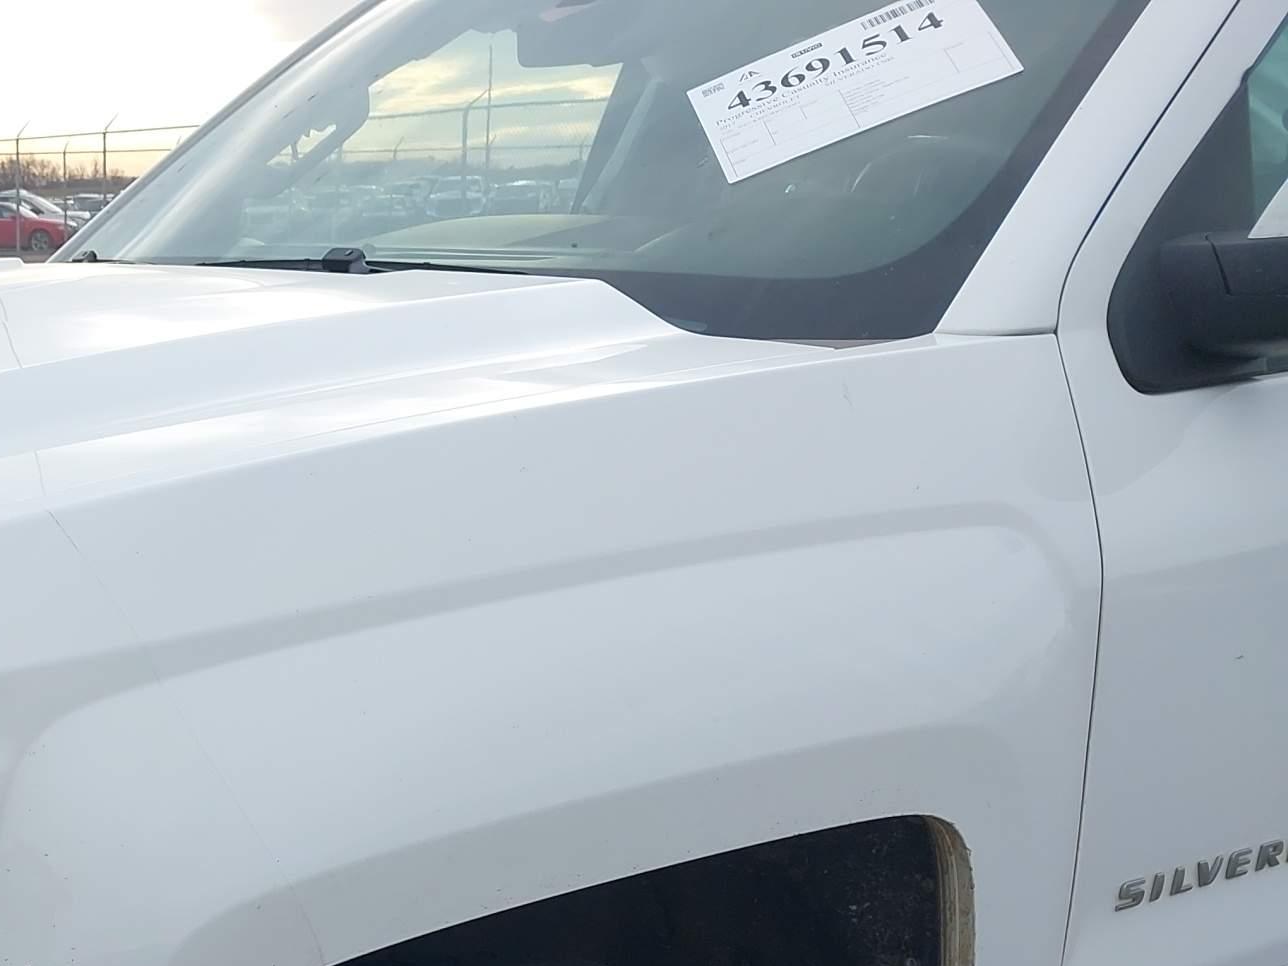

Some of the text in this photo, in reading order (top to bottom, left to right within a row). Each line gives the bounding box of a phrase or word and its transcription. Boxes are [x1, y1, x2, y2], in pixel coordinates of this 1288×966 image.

[716, 97, 777, 126] Progressive
[781, 75, 829, 100] Casualty
[833, 52, 887, 77] Insurance
[728, 12, 943, 110] 43691514
[1115, 839, 1288, 912] SILVER
